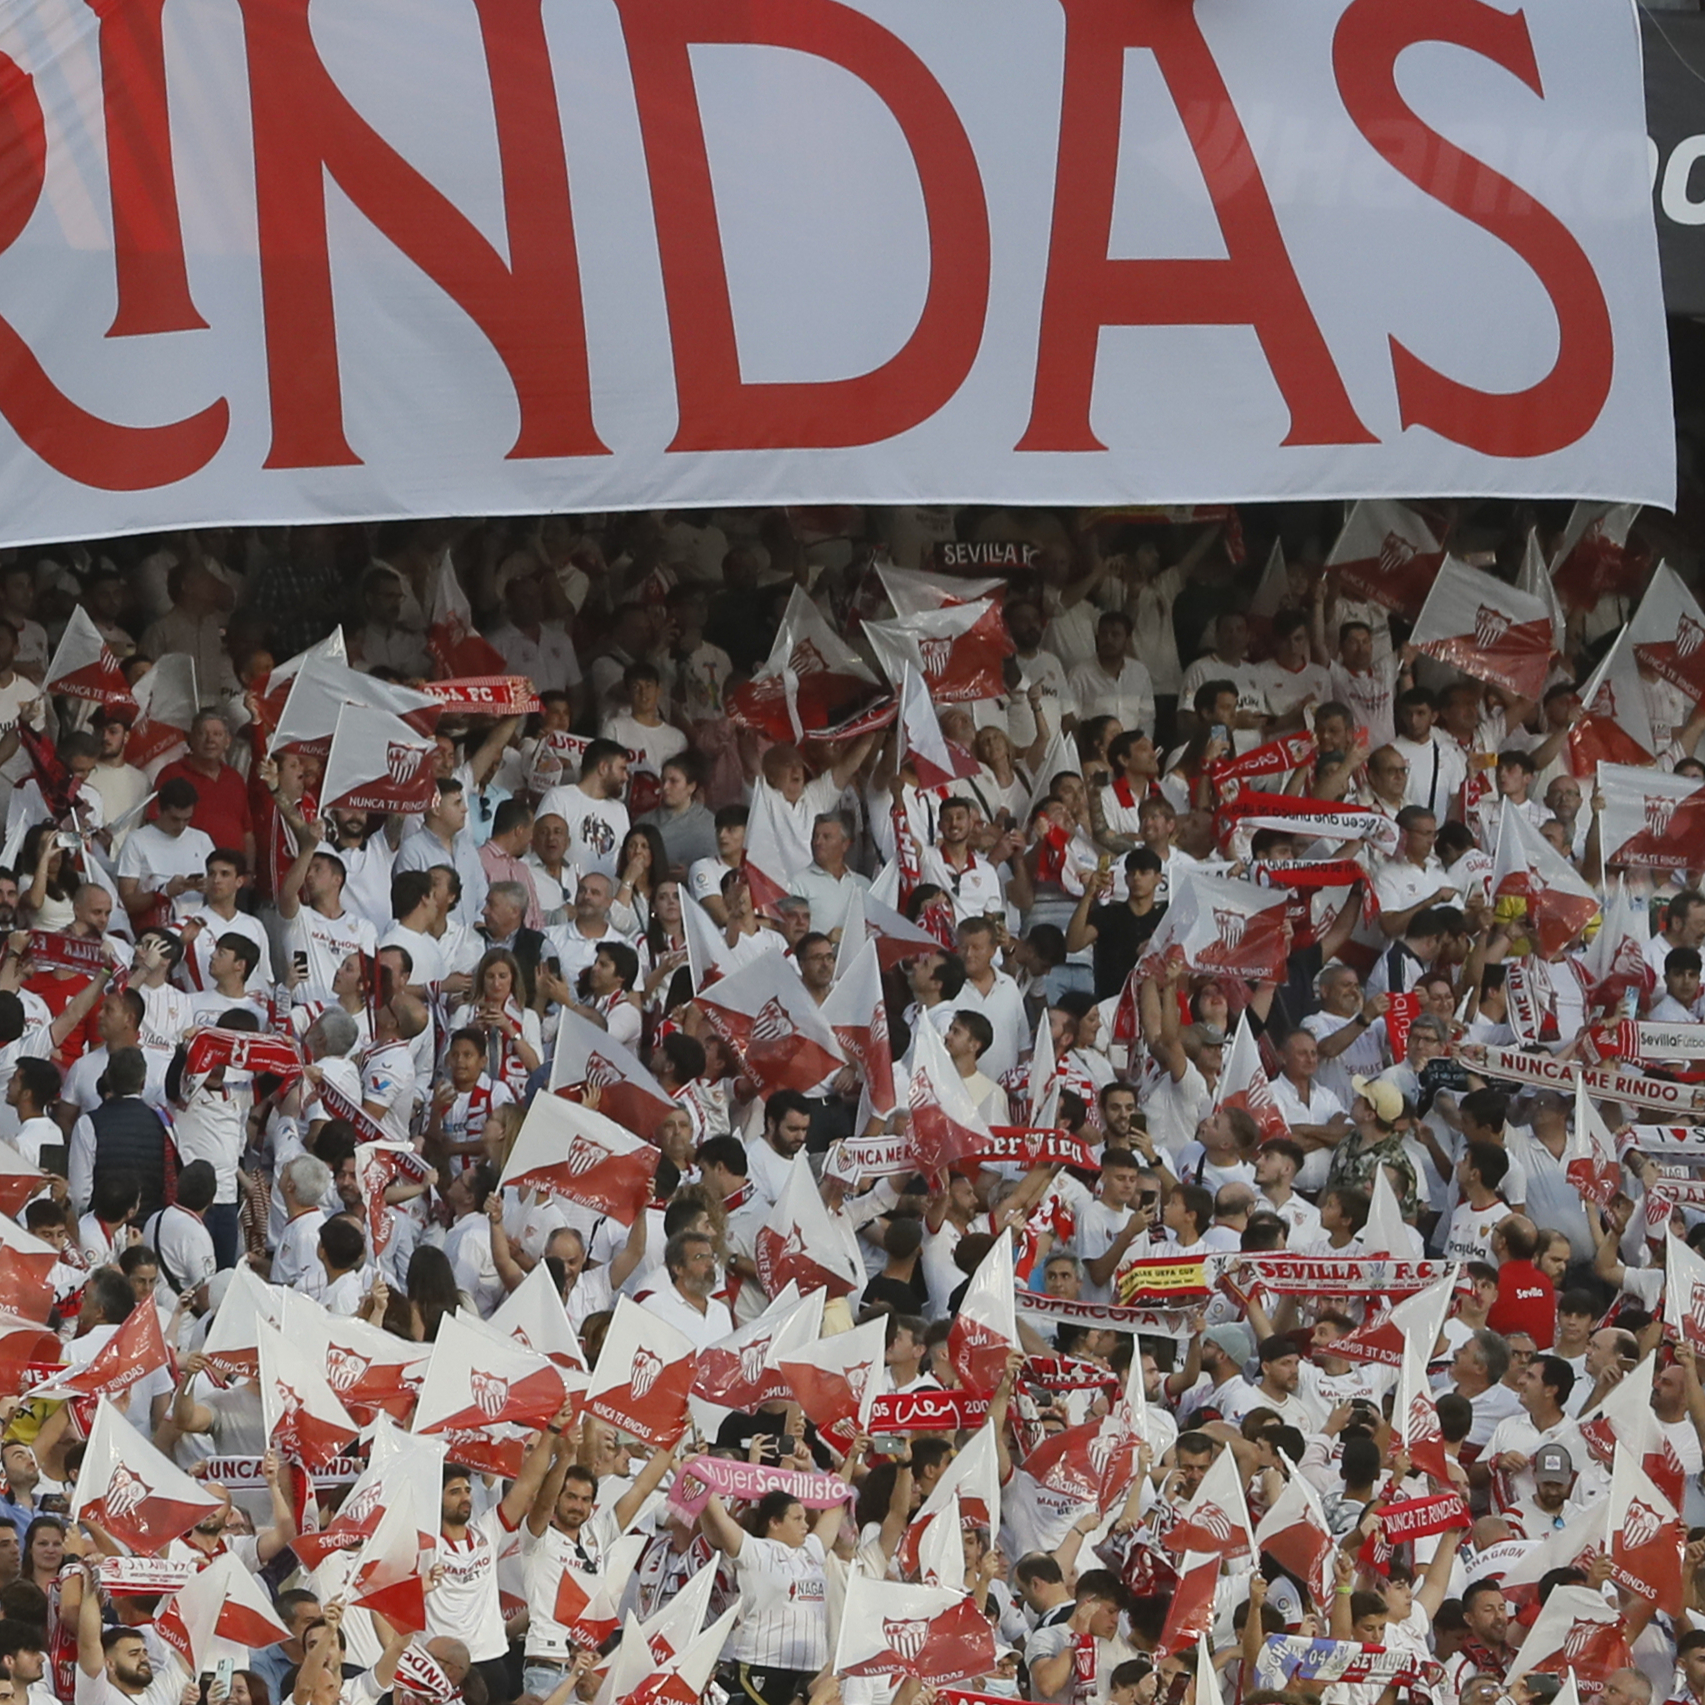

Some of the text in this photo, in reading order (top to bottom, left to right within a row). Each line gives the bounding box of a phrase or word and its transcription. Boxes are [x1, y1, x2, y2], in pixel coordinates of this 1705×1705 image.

[944, 543, 1020, 565] SEVILLA
[349, 796, 399, 810] NUNCA TE
[1500, 1052, 1679, 1102] NUNCA ME RINDO
[1259, 1261, 1436, 1279] SEVILLA F.C.
[1515, 1287, 1543, 1300] Sevilla
[108, 1364, 145, 1390] RINDAS
[592, 1401, 653, 1438] NUNCA TE RINDAS
[1384, 1504, 1462, 1533] NUNCA TE RINDAS
[797, 1583, 824, 1596] NAGA
[1618, 1570, 1658, 1600] RINDAS
